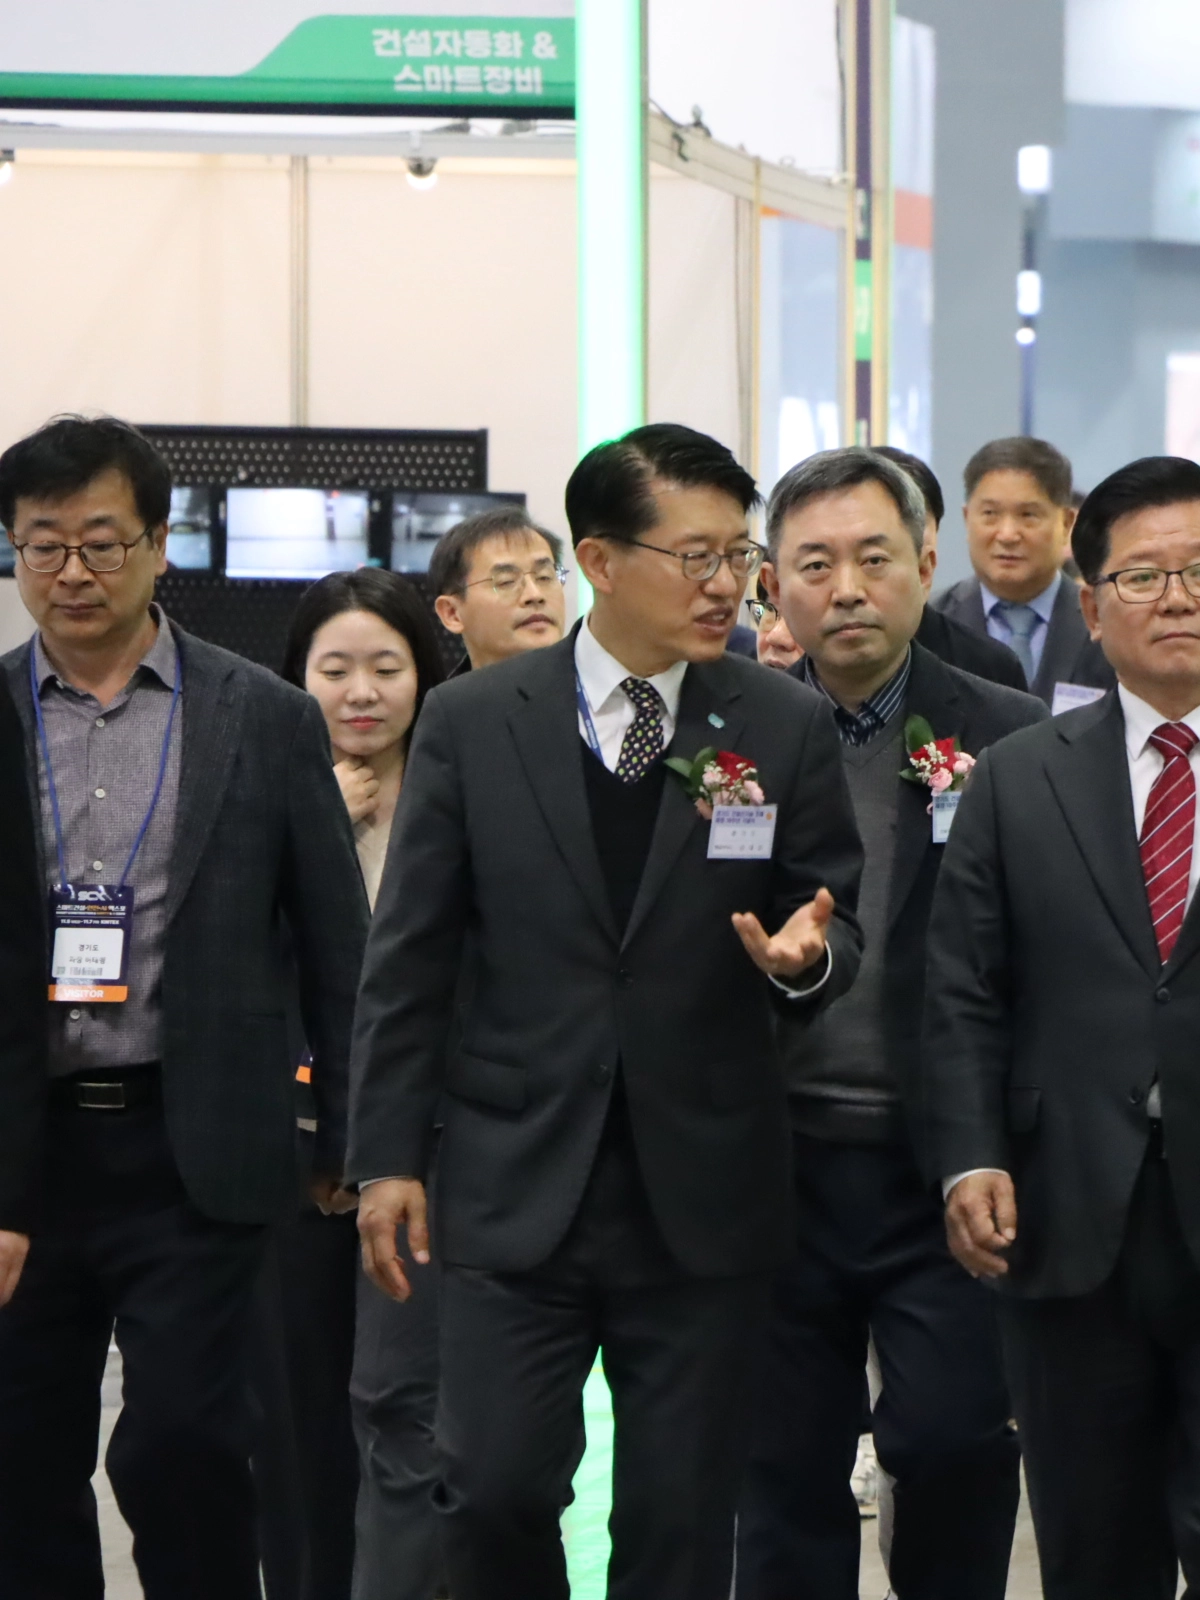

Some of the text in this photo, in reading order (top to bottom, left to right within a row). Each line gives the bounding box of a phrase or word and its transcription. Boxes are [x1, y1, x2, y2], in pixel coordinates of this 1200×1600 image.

[372, 28, 558, 59] 건설자동화 &
[393, 64, 543, 95] 스마트장비
[78, 944, 99, 952] 경기도
[63, 989, 104, 998] VISITOR
